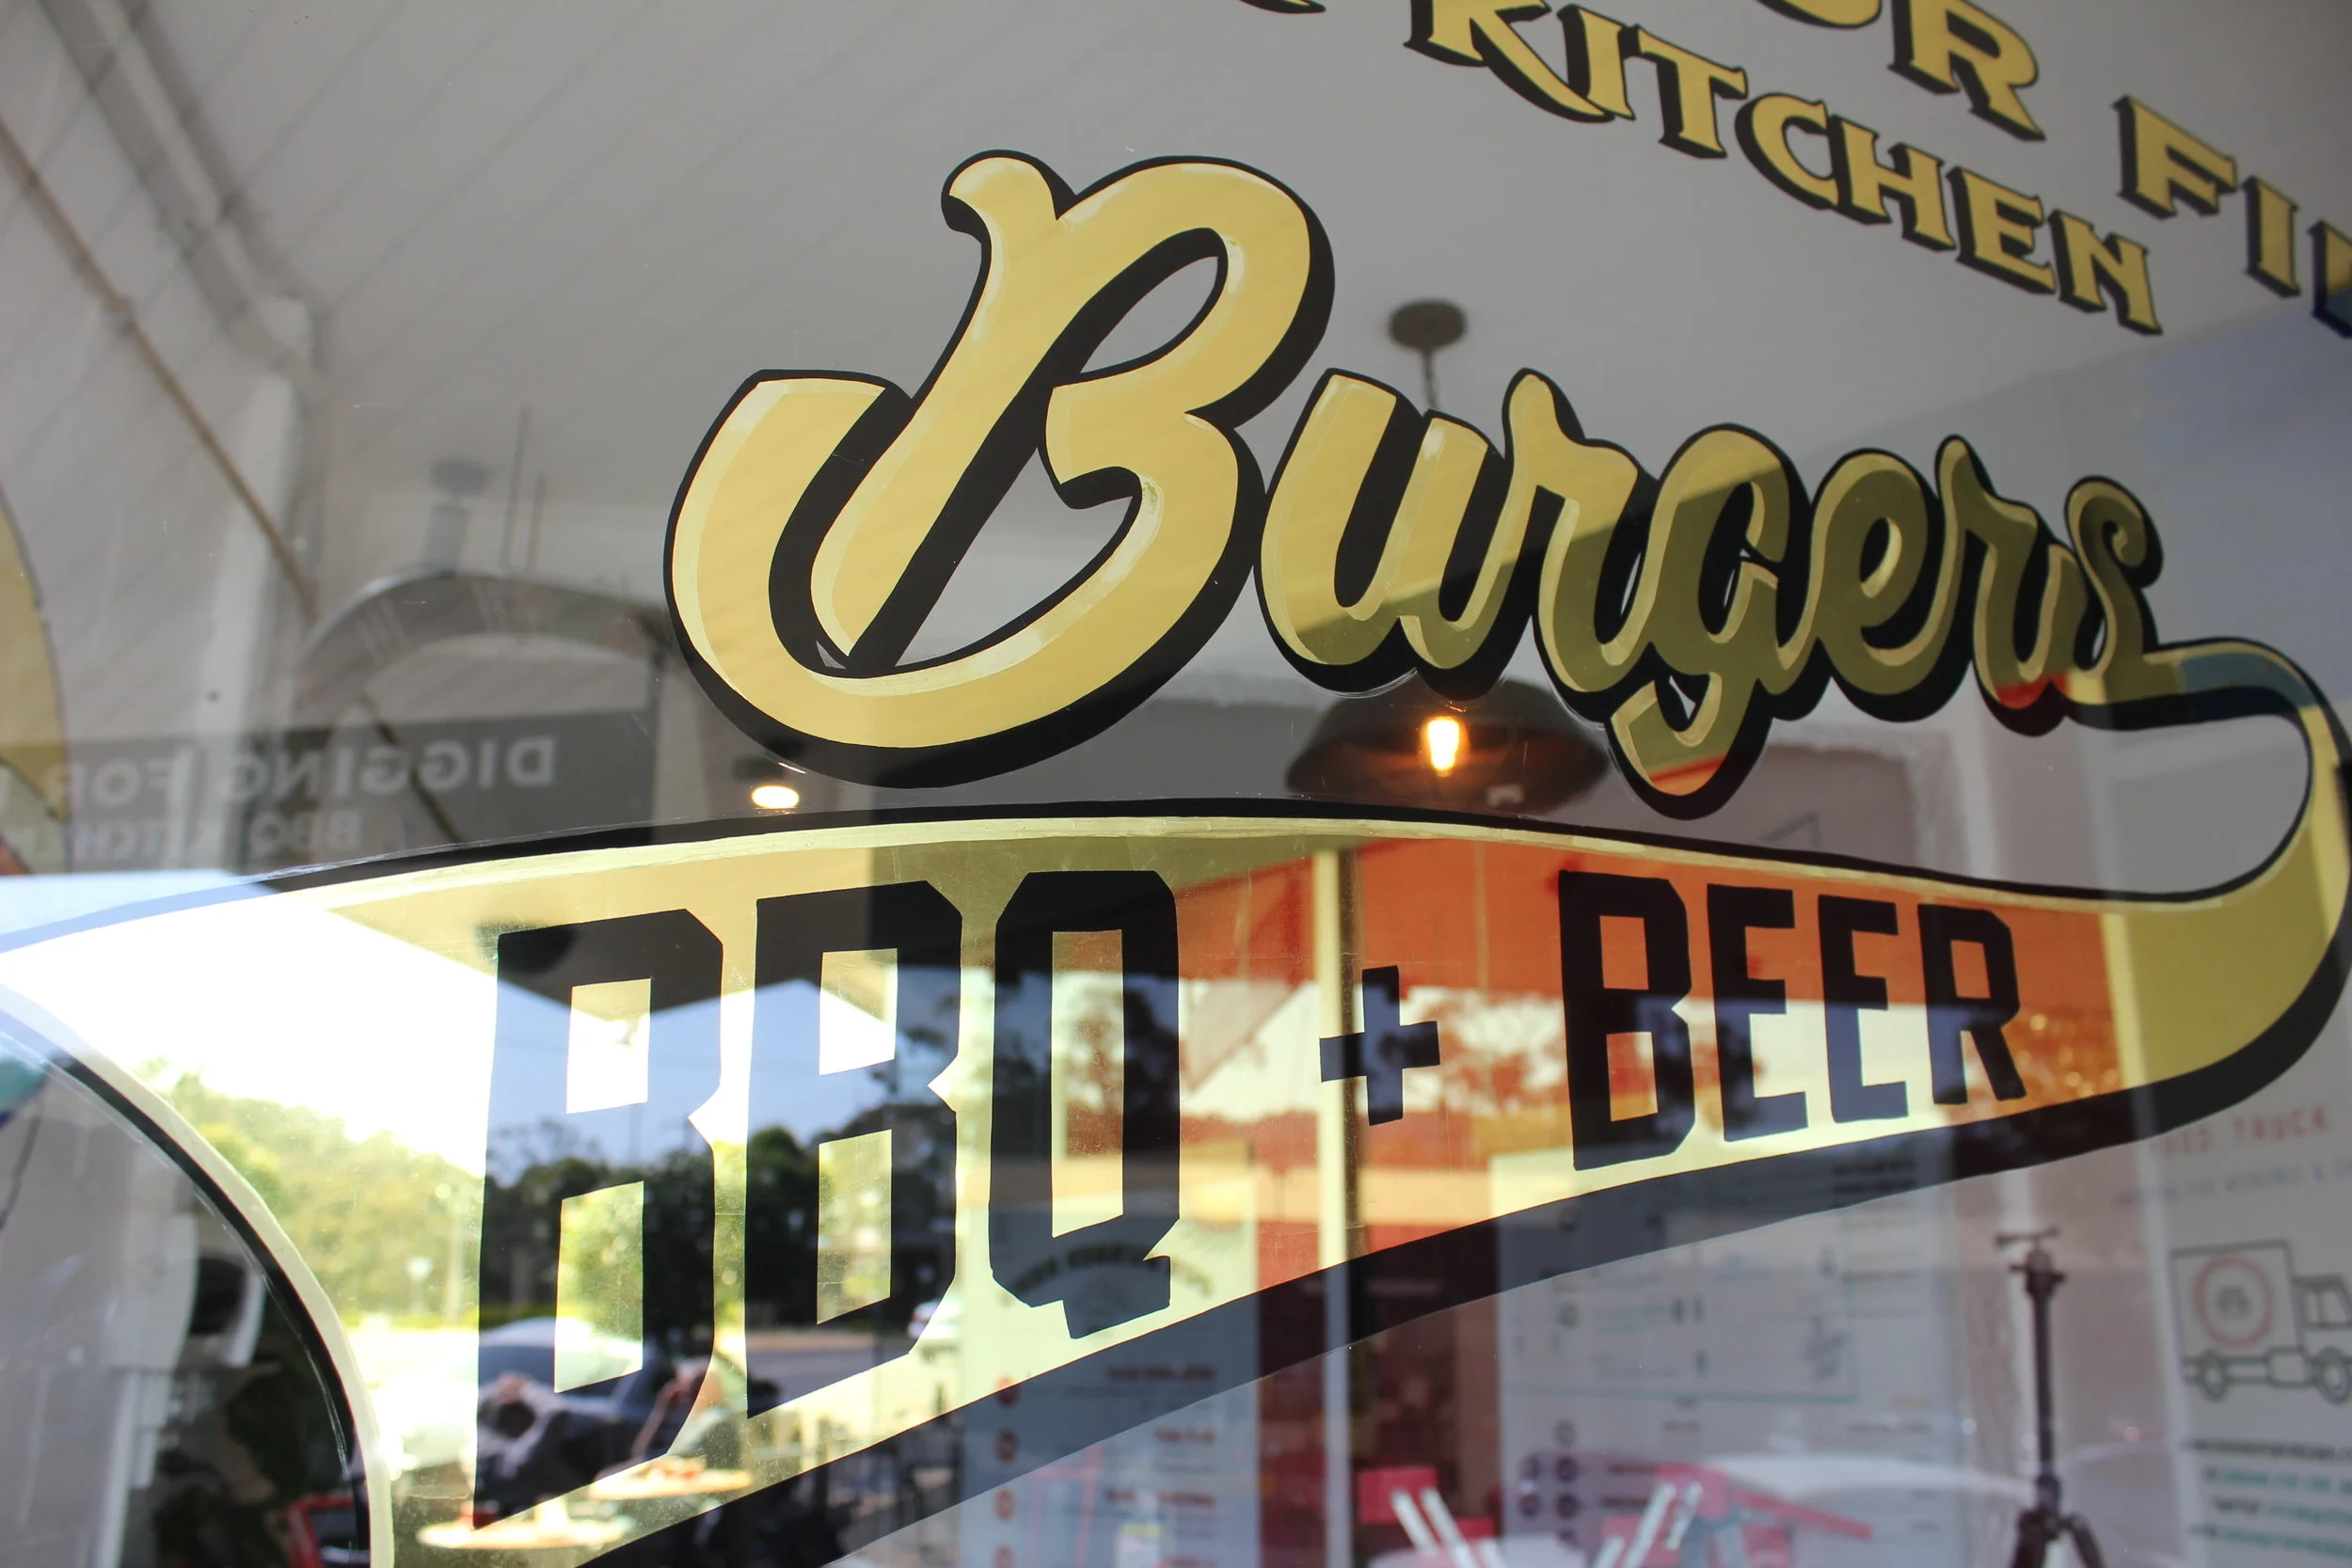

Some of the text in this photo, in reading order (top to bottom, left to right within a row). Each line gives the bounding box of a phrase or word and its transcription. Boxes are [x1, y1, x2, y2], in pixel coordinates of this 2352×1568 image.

[664, 149, 2166, 819] Burgers
[1404, 0, 2162, 336] KITCHEN
[473, 870, 1180, 1529] BBQ
[1558, 869, 2026, 1170] BEER
